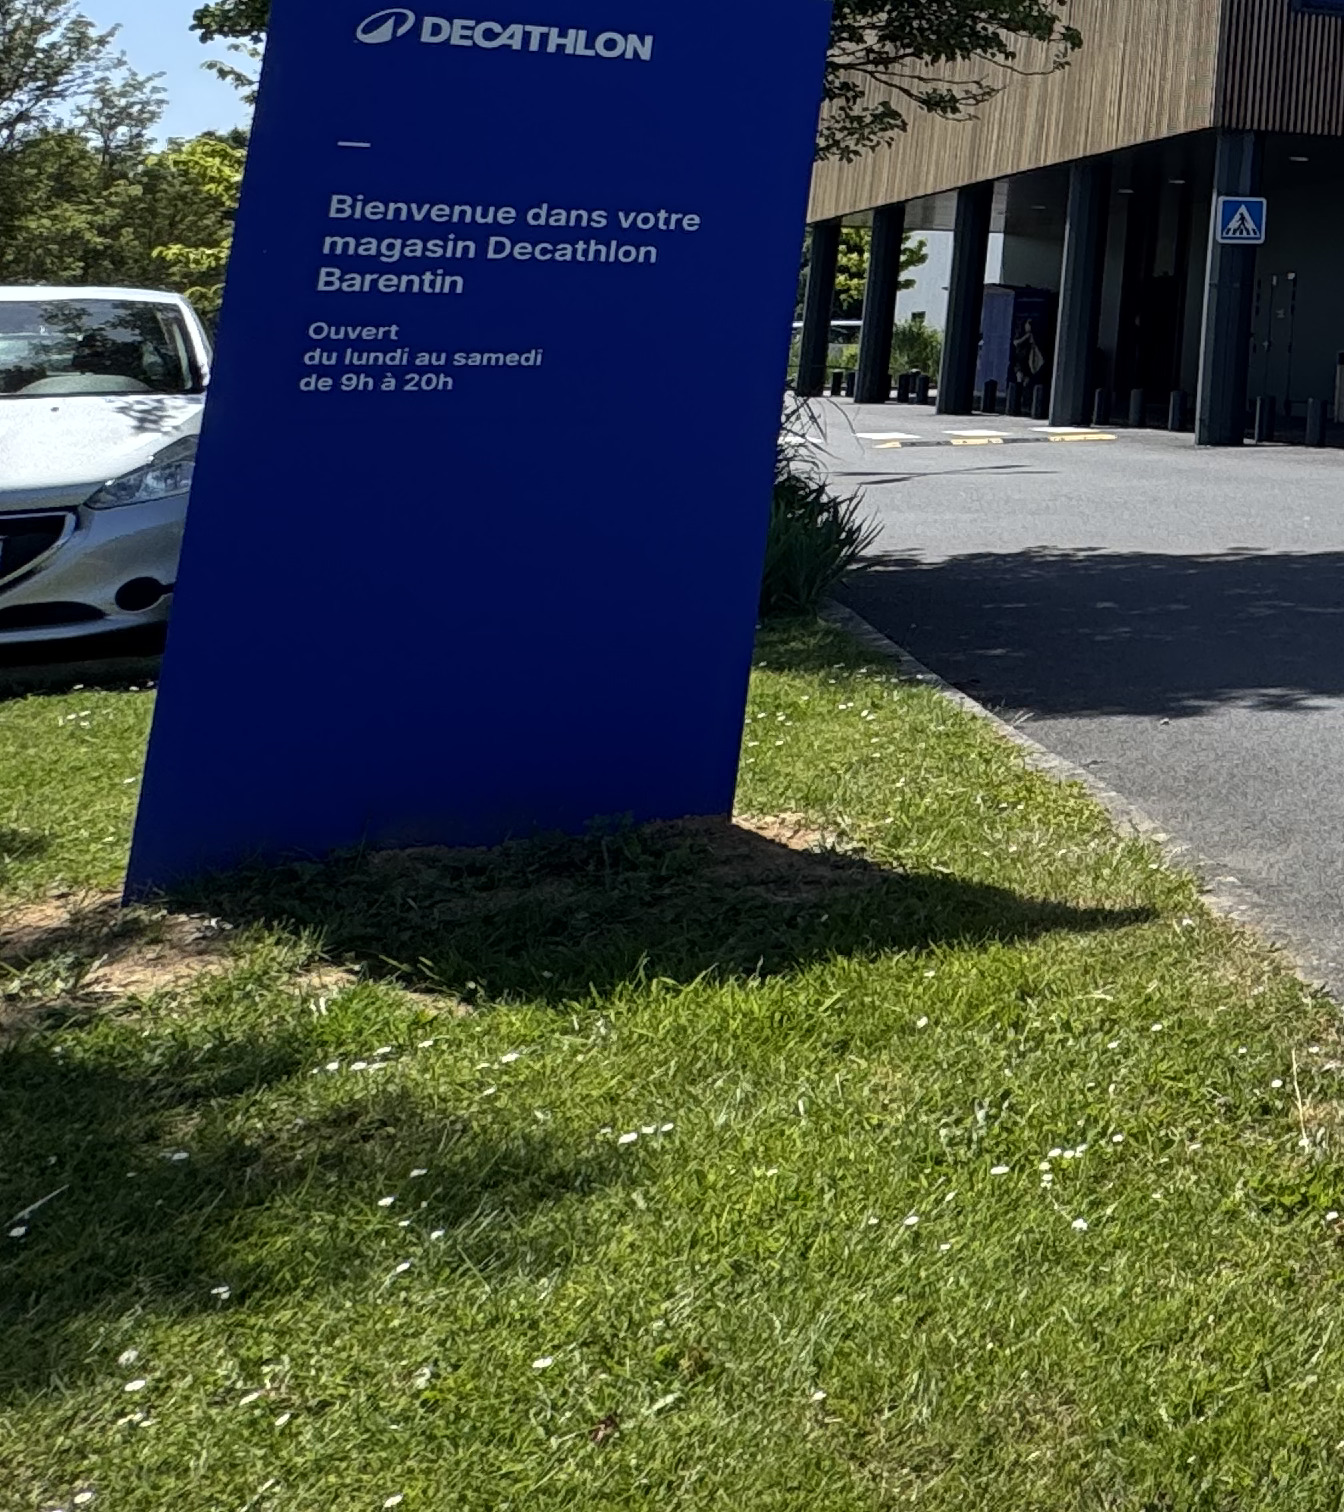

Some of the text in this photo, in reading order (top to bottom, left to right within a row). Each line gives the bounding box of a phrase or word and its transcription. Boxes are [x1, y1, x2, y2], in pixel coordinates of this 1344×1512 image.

[419, 16, 655, 61] DECATHLON
[328, 193, 702, 232] Bienvenue dans votre
[322, 233, 658, 264] magasin Decathlon
[316, 266, 465, 295] Barentin
[307, 321, 400, 341] Ouvert
[302, 347, 544, 367] du lundi au samedi
[298, 372, 454, 392] de 9h à 20h
